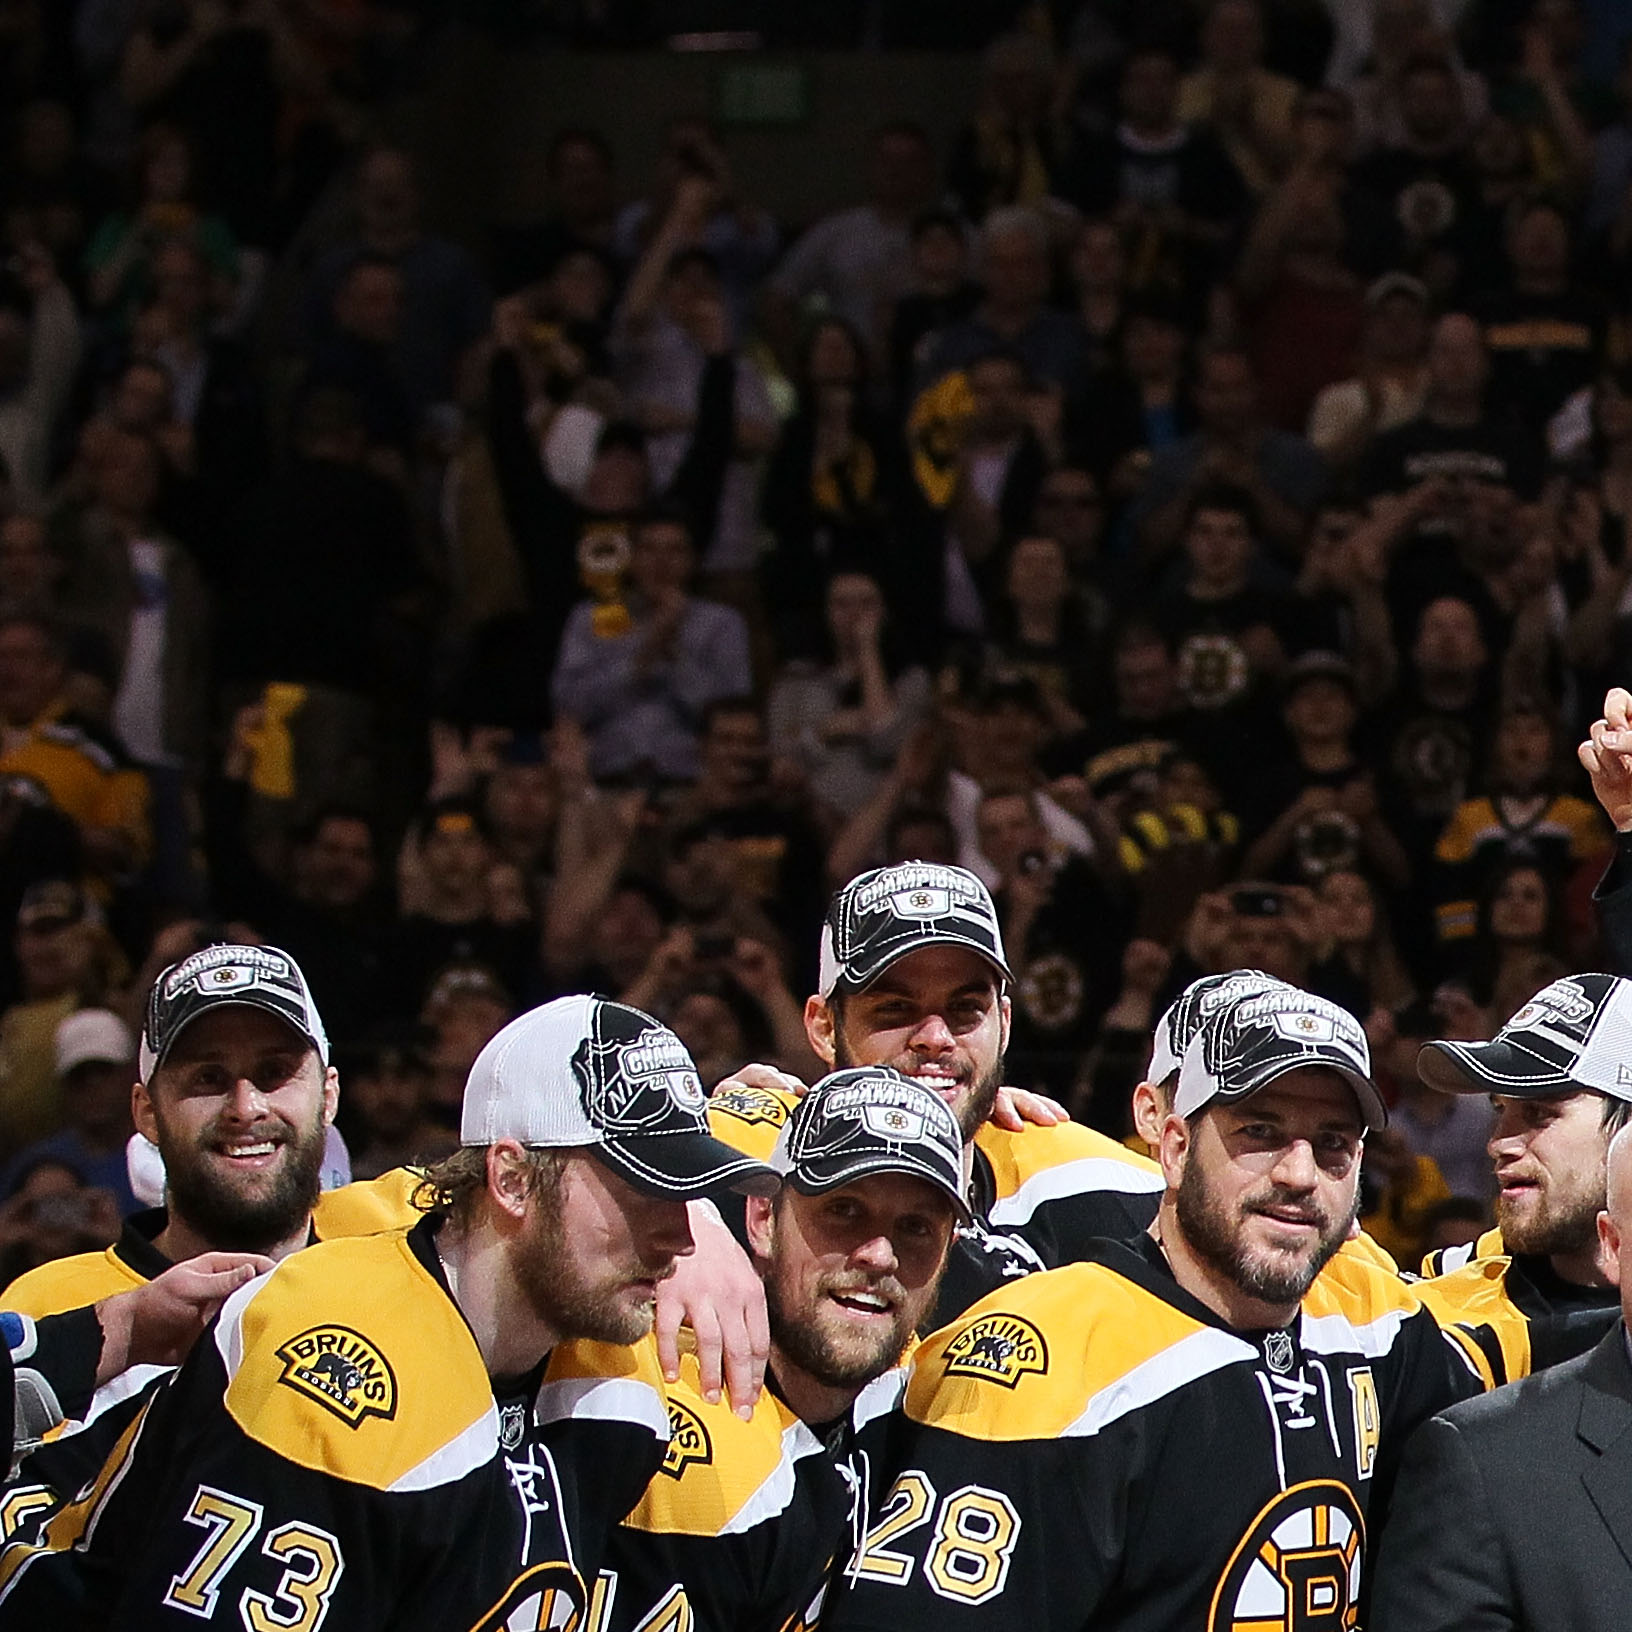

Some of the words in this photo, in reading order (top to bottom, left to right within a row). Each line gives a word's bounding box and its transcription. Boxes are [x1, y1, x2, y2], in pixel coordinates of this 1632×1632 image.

[291, 1334, 387, 1402] BRUINS
[955, 1320, 1037, 1363] BRUINS
[1351, 1366, 1380, 1480] A
[844, 1469, 1022, 1605] 28
